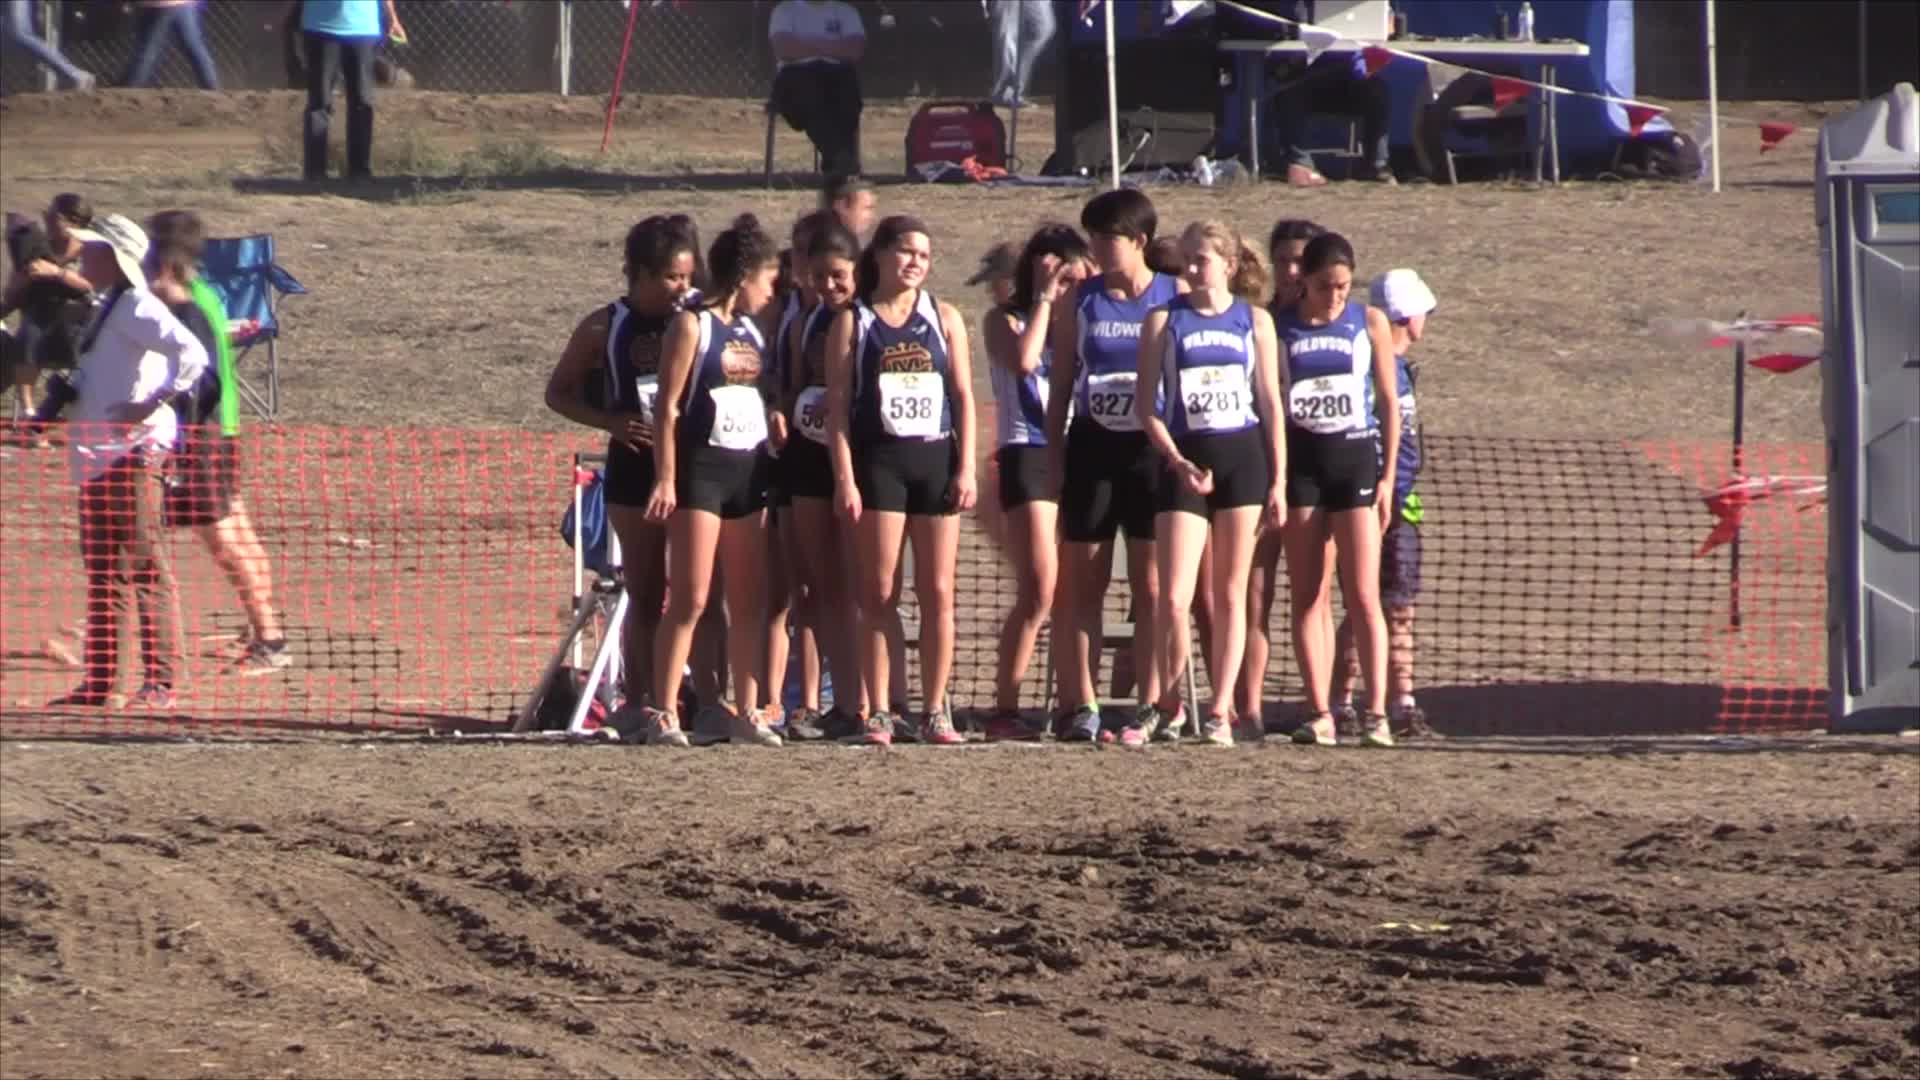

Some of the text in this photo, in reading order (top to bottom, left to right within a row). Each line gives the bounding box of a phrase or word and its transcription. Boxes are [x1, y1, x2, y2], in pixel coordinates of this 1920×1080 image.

[1088, 321, 1143, 338] WILDW
[889, 396, 932, 420] 538
[1090, 392, 1136, 417] 327
[1187, 390, 1241, 415] 3281
[1293, 393, 1353, 420] 3280
